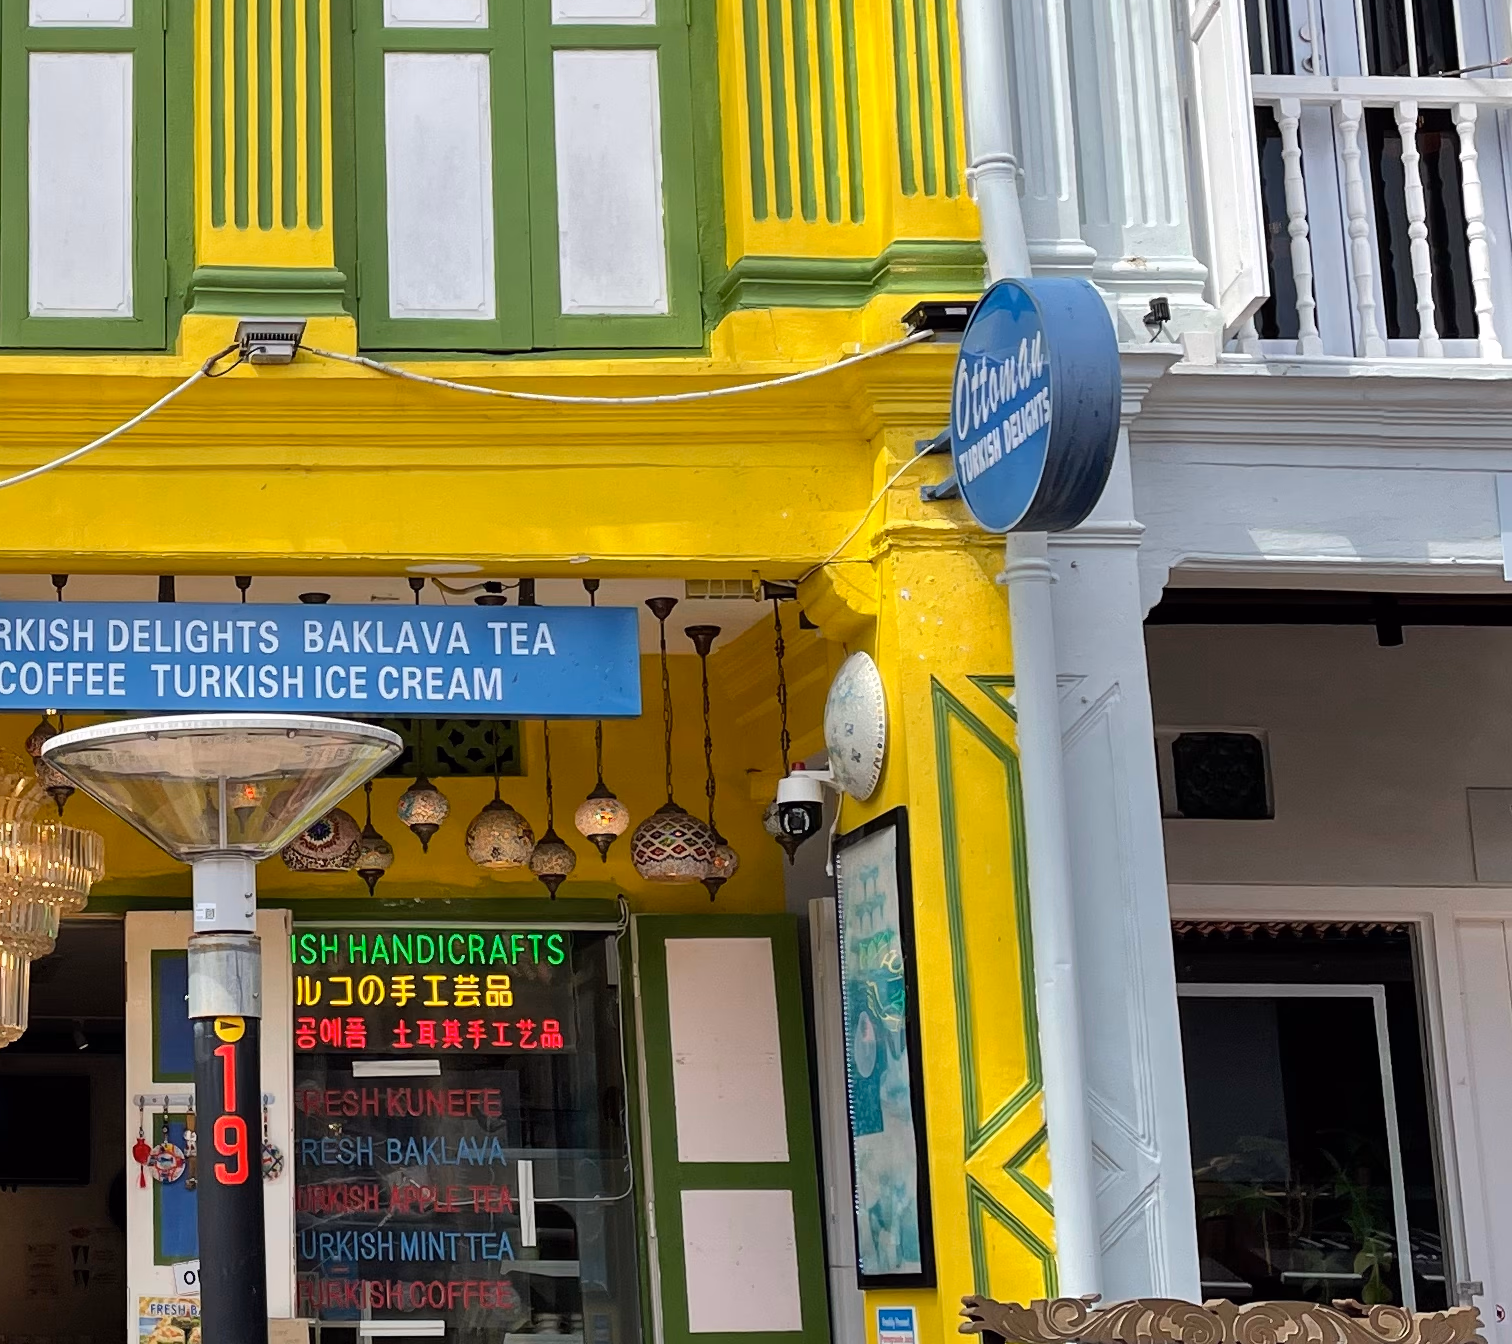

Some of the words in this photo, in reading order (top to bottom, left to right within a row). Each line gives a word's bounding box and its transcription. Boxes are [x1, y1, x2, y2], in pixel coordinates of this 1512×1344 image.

[955, 330, 1045, 441] Ottoman
[958, 430, 1001, 486] TURKISH
[1003, 387, 1052, 456] DELIGHTS
[107, 619, 279, 654] DELIGHTS
[304, 621, 469, 655] BAKLAVA
[488, 622, 556, 656] TEA
[150, 663, 303, 698] TURKISH
[314, 665, 368, 699] ICE
[377, 666, 503, 701] CREAM
[291, 933, 339, 965] ISH
[348, 933, 566, 965] HANDICRAFTS
[296, 974, 514, 1007] ルコの手工芸品
[295, 1015, 367, 1050] 공예품
[387, 1087, 503, 1118] KUNEFE
[301, 1137, 374, 1166] RESH
[387, 1136, 507, 1166] BAKLAVA
[296, 1185, 380, 1214] URKISH
[390, 1185, 461, 1214] APPLE
[468, 1185, 514, 1214] TEA
[299, 1231, 394, 1261] URKISH
[400, 1231, 461, 1261] MINT
[464, 1231, 515, 1262] TEA
[150, 1303, 186, 1316] FRESH
[409, 1280, 516, 1311] COFFEE
